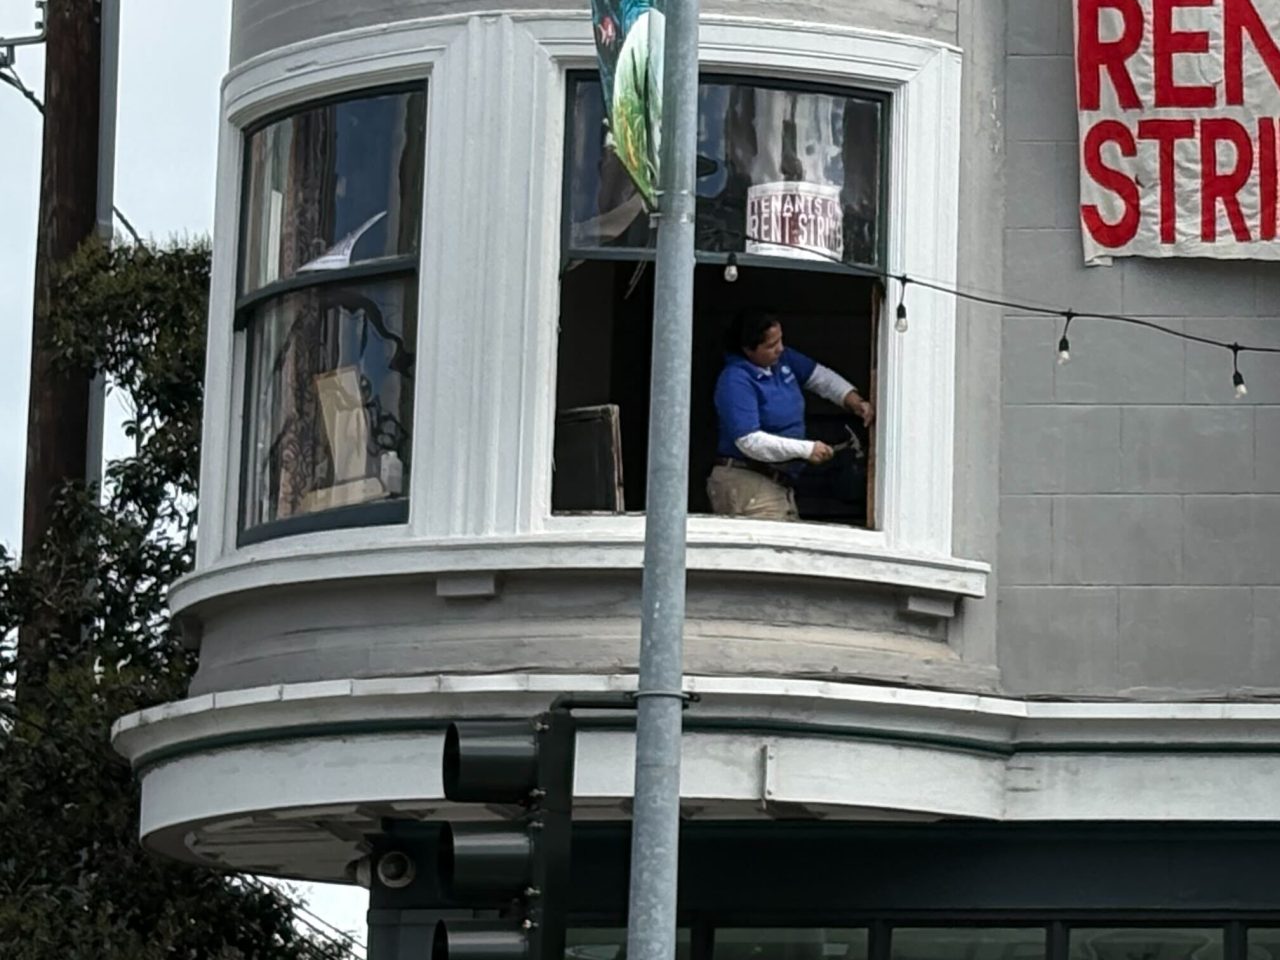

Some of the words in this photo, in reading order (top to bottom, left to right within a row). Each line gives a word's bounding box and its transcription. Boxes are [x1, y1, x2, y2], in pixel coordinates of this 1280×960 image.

[750, 193, 823, 215] TENANTS
[750, 212, 793, 244] RENT
[798, 214, 843, 252] STRIKE
